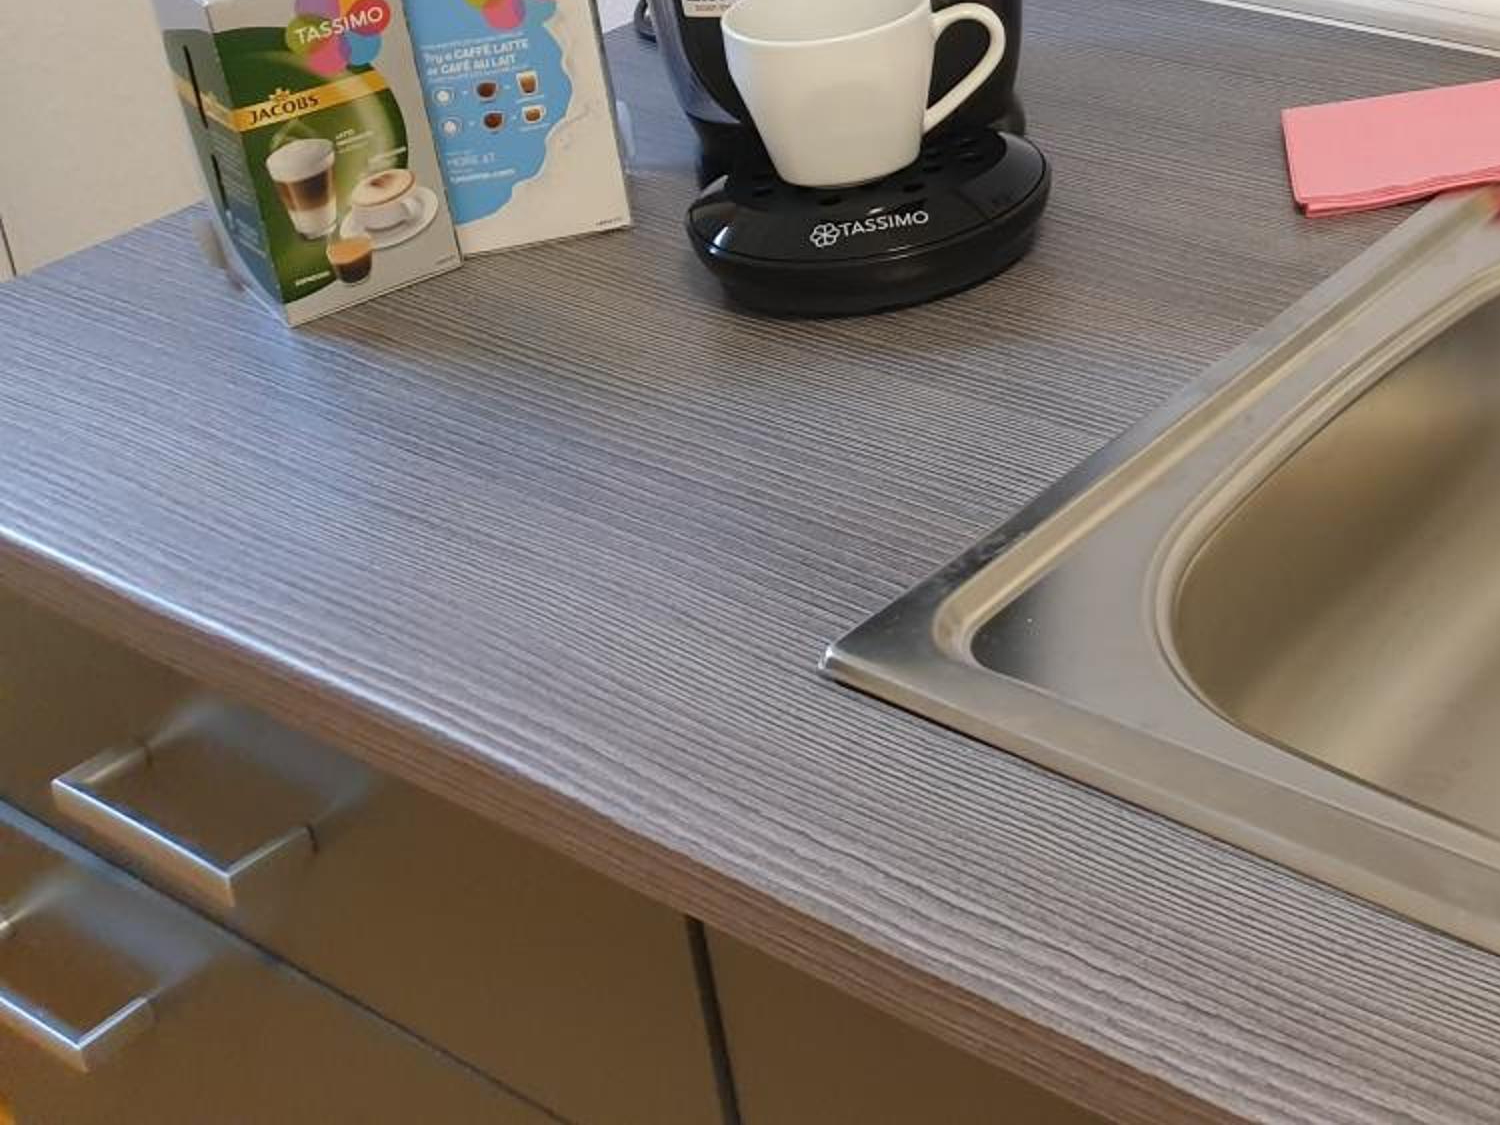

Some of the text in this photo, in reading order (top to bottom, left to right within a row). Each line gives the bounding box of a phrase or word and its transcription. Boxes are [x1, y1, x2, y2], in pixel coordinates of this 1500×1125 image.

[294, 6, 384, 45] TASSIMO
[493, 38, 529, 53] LATTE
[250, 95, 320, 124] JACOBS
[838, 211, 929, 237] TASSIMO
